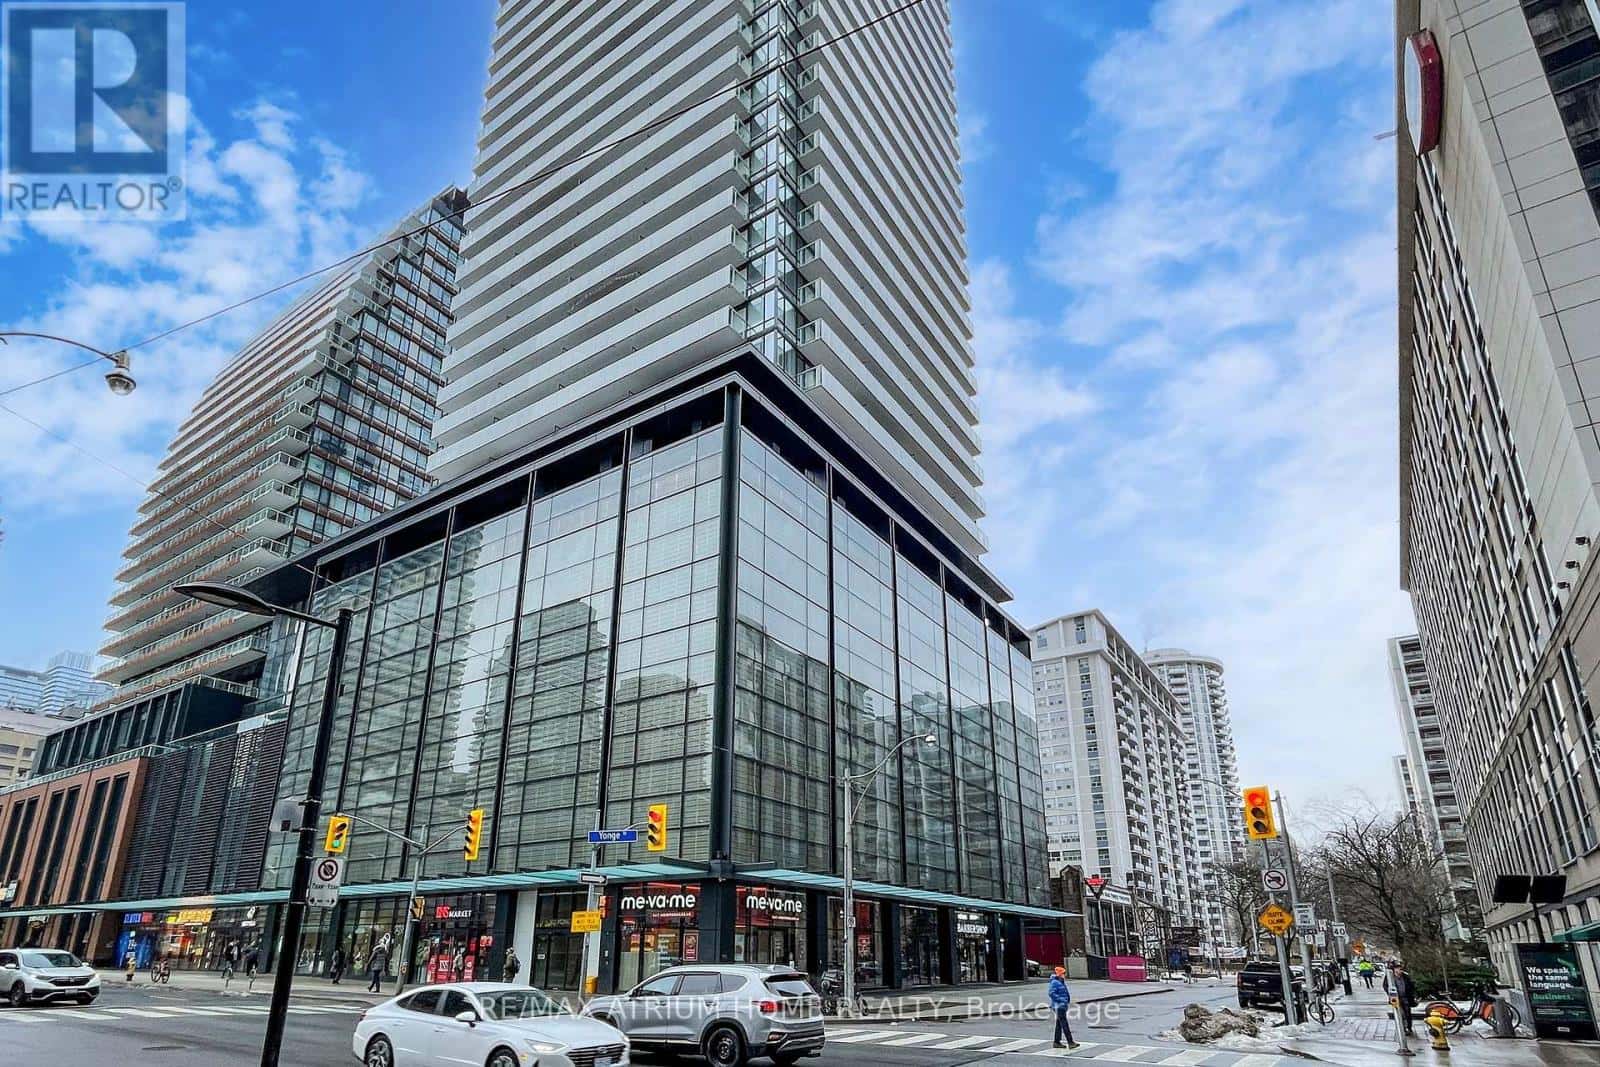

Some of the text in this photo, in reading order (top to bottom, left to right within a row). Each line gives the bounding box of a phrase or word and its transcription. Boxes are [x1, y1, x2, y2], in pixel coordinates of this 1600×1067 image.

[599, 831, 621, 842] Yonge
[449, 910, 472, 918] MARKET
[1543, 967, 1569, 975] speak
